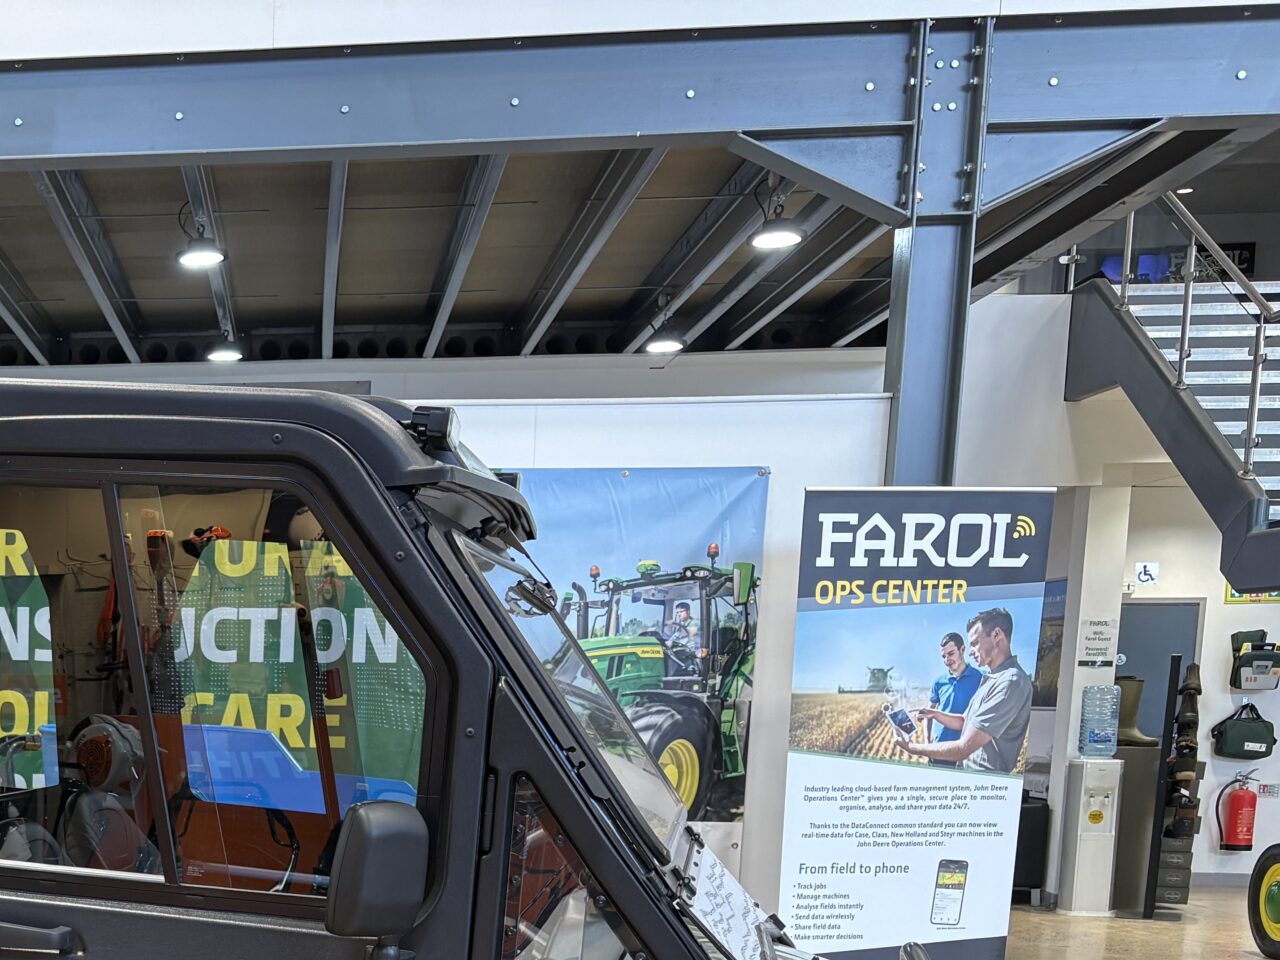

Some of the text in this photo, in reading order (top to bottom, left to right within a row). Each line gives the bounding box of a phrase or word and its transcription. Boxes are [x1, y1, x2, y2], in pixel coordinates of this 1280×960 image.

[815, 512, 1030, 568] FAROL
[815, 579, 968, 605] OPS CENTER
[804, 785, 830, 794] Industry
[831, 785, 854, 794] leading
[804, 795, 838, 803] Operations
[867, 795, 884, 803] gives
[907, 794, 926, 803] single,
[951, 794, 968, 802] place
[839, 804, 867, 813] organise,
[868, 803, 893, 812] analyse,
[891, 840, 924, 848] Operations
[799, 862, 910, 877] From field to phone
[814, 883, 827, 891] jobs
[797, 893, 821, 902] Manage
[796, 903, 819, 912] Analyse
[838, 902, 864, 911] instantly
[826, 913, 856, 921] wirelessly
